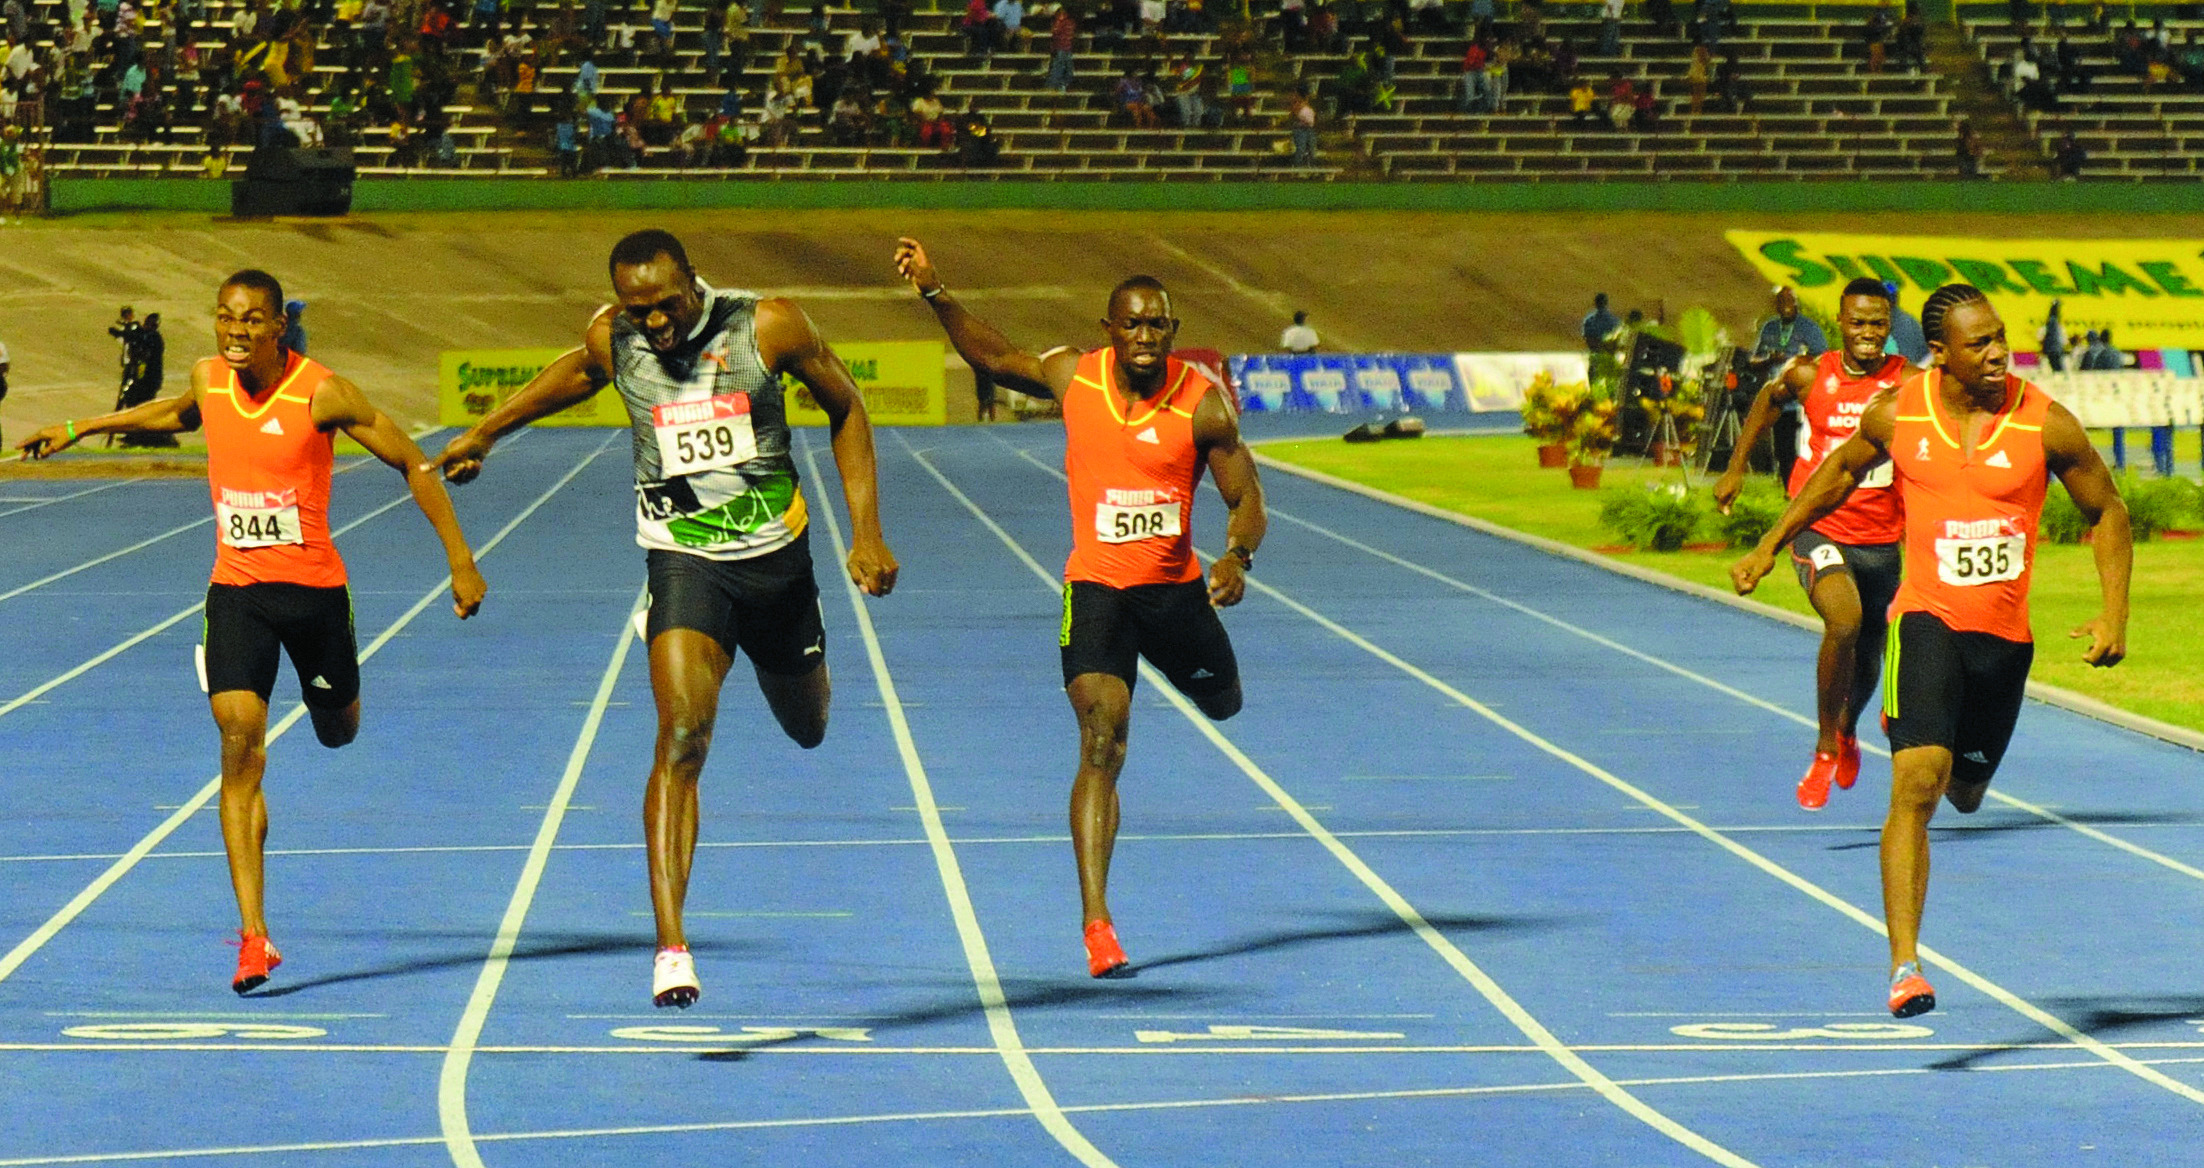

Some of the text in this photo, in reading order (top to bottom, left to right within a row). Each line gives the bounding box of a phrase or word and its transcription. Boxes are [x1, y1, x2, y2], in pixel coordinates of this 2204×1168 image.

[1759, 240, 2204, 298] SUPREME
[459, 362, 546, 392] SUPREM
[661, 400, 715, 426] PUMA
[1838, 402, 1866, 414] UW
[1828, 416, 1861, 428] MO
[677, 426, 735, 464] 539
[222, 487, 265, 508] PUMA
[1106, 489, 1154, 506] PUMA
[230, 514, 281, 540] 844
[1115, 512, 1164, 538] 508
[1945, 519, 2001, 538] PUMA
[1820, 548, 1832, 560] 2
[1957, 543, 2009, 577] 535
[1134, 1025, 1405, 1043] 4
[1670, 1022, 1934, 1040] 3
